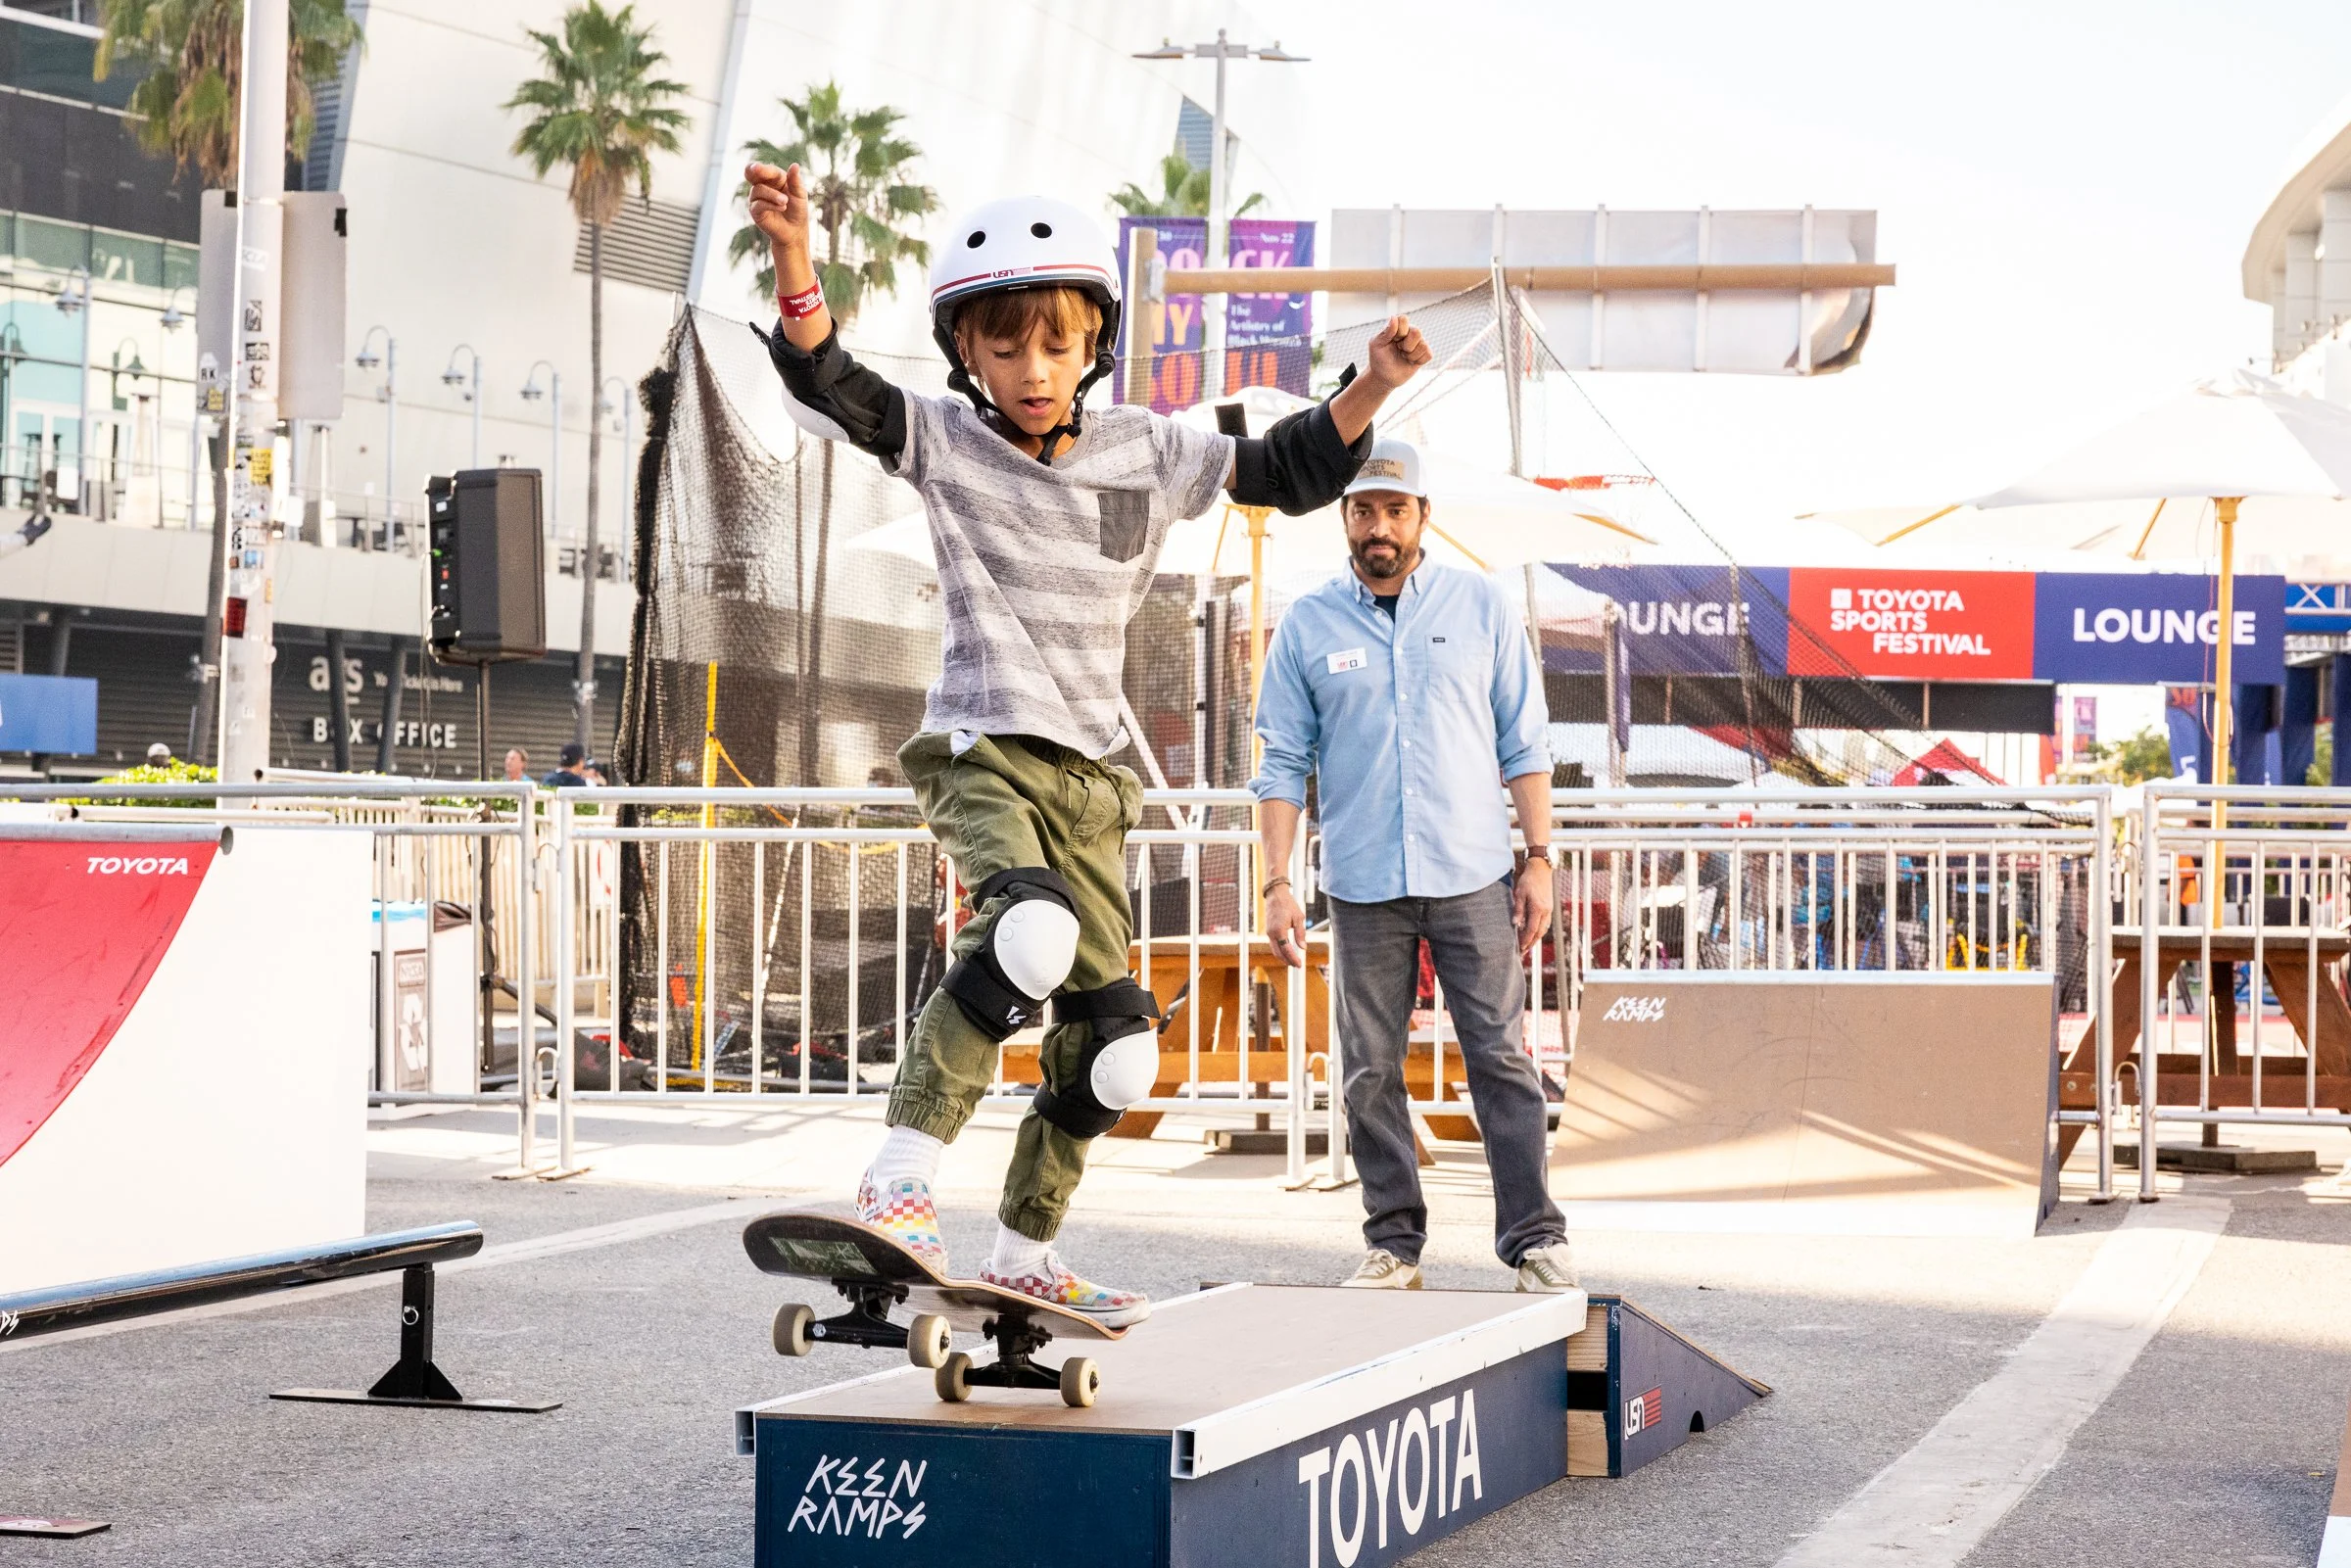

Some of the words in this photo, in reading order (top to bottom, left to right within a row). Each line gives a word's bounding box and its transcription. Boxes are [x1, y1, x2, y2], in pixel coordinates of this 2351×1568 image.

[1857, 589, 1965, 611] TOYOTA
[1613, 600, 1751, 637] UNGE
[1830, 610, 1928, 632] SPORTS
[2073, 607, 2257, 645] LOUNGE
[1873, 633, 1991, 655] FESTIVAL
[312, 716, 363, 744] BX
[86, 857, 189, 876] TOYOTA
[804, 1454, 927, 1498] KEEN
[1298, 1388, 1483, 1568] TOYOTA
[787, 1495, 927, 1540] RAMPS
